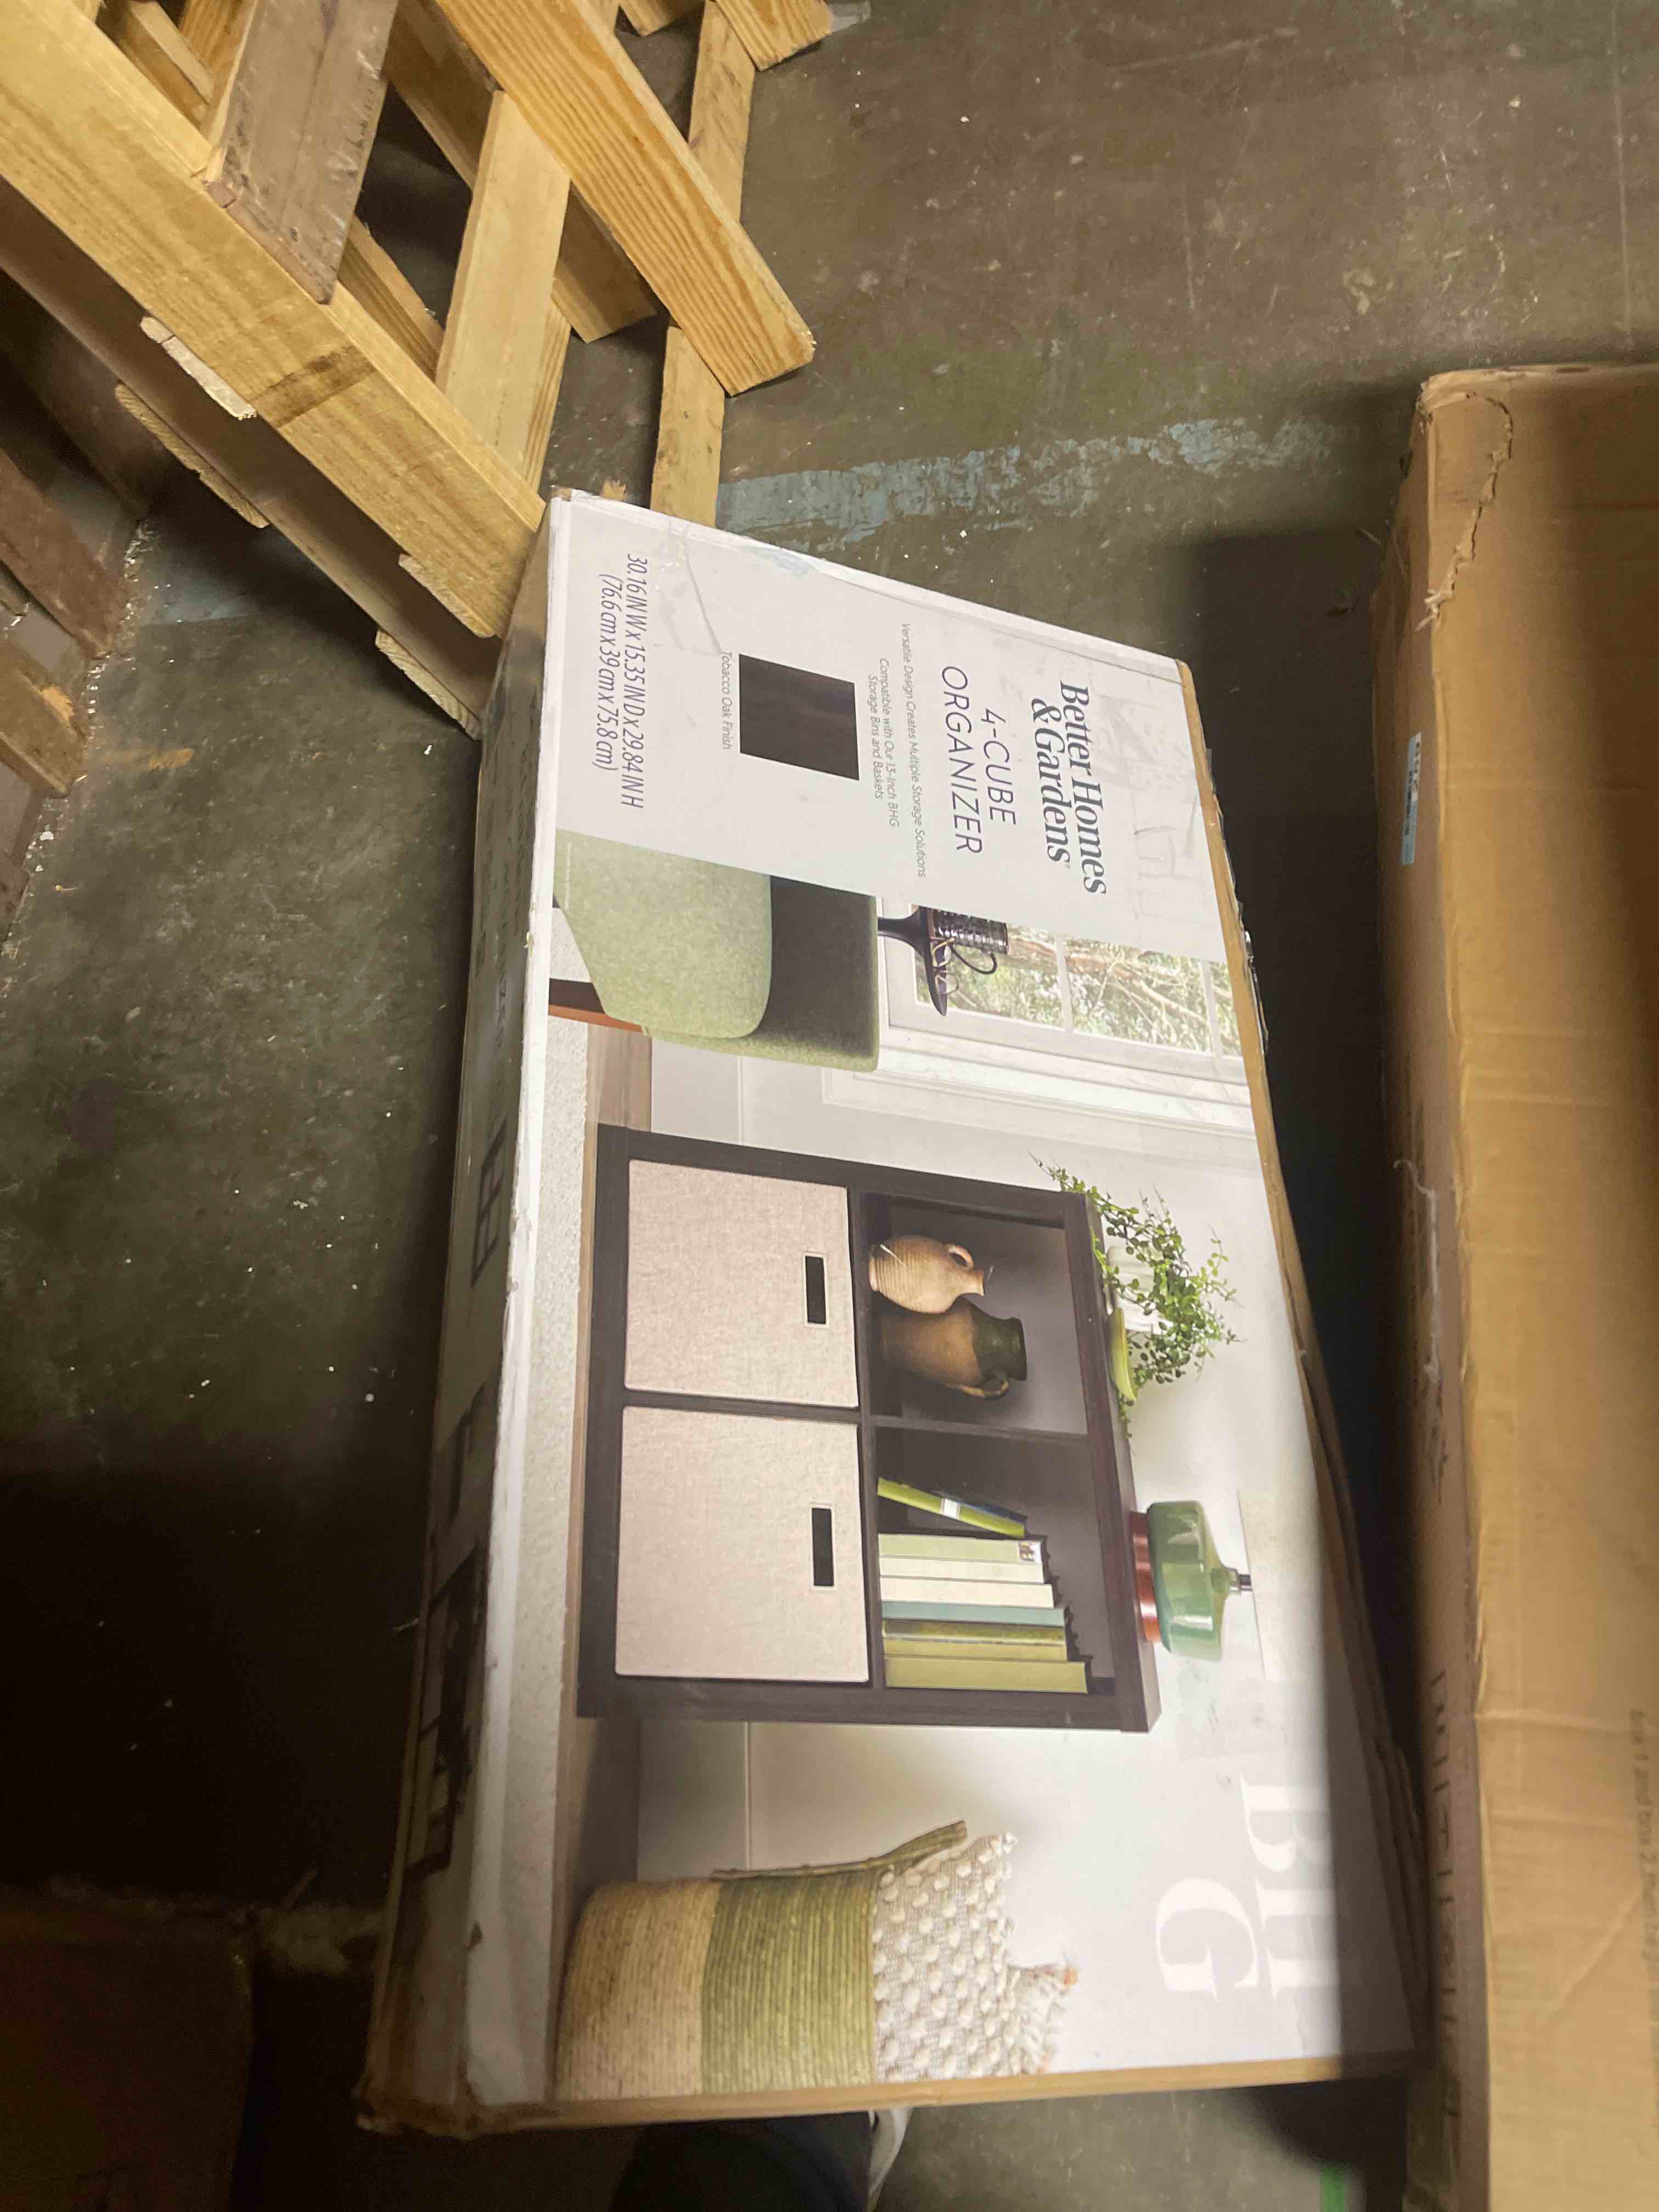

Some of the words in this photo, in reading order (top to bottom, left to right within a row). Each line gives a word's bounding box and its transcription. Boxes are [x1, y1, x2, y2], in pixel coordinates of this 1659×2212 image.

[901, 623, 912, 663] Versatile
[721, 650, 733, 695] Tobacco
[877, 658, 892, 715] Compatible
[902, 665, 915, 699] Design
[721, 697, 732, 718] Oak
[867, 674, 878, 714] Storage
[722, 720, 733, 749] Finish
[871, 716, 881, 736] Bins
[883, 718, 894, 738] with
[906, 701, 916, 738] Creates
[1060, 680, 1093, 776] Better
[872, 738, 883, 759] and
[884, 741, 895, 761] Our
[909, 741, 921, 782] Multiple
[942, 666, 982, 853] ORGANIZER
[981, 708, 1016, 825] 4-CUBE
[873, 761, 884, 800] Baskets
[885, 762, 897, 799] 13-Inch
[887, 802, 899, 827] BHG
[910, 785, 922, 826] Storage
[915, 828, 926, 878] Solutions
[1071, 777, 1106, 894] Homes
